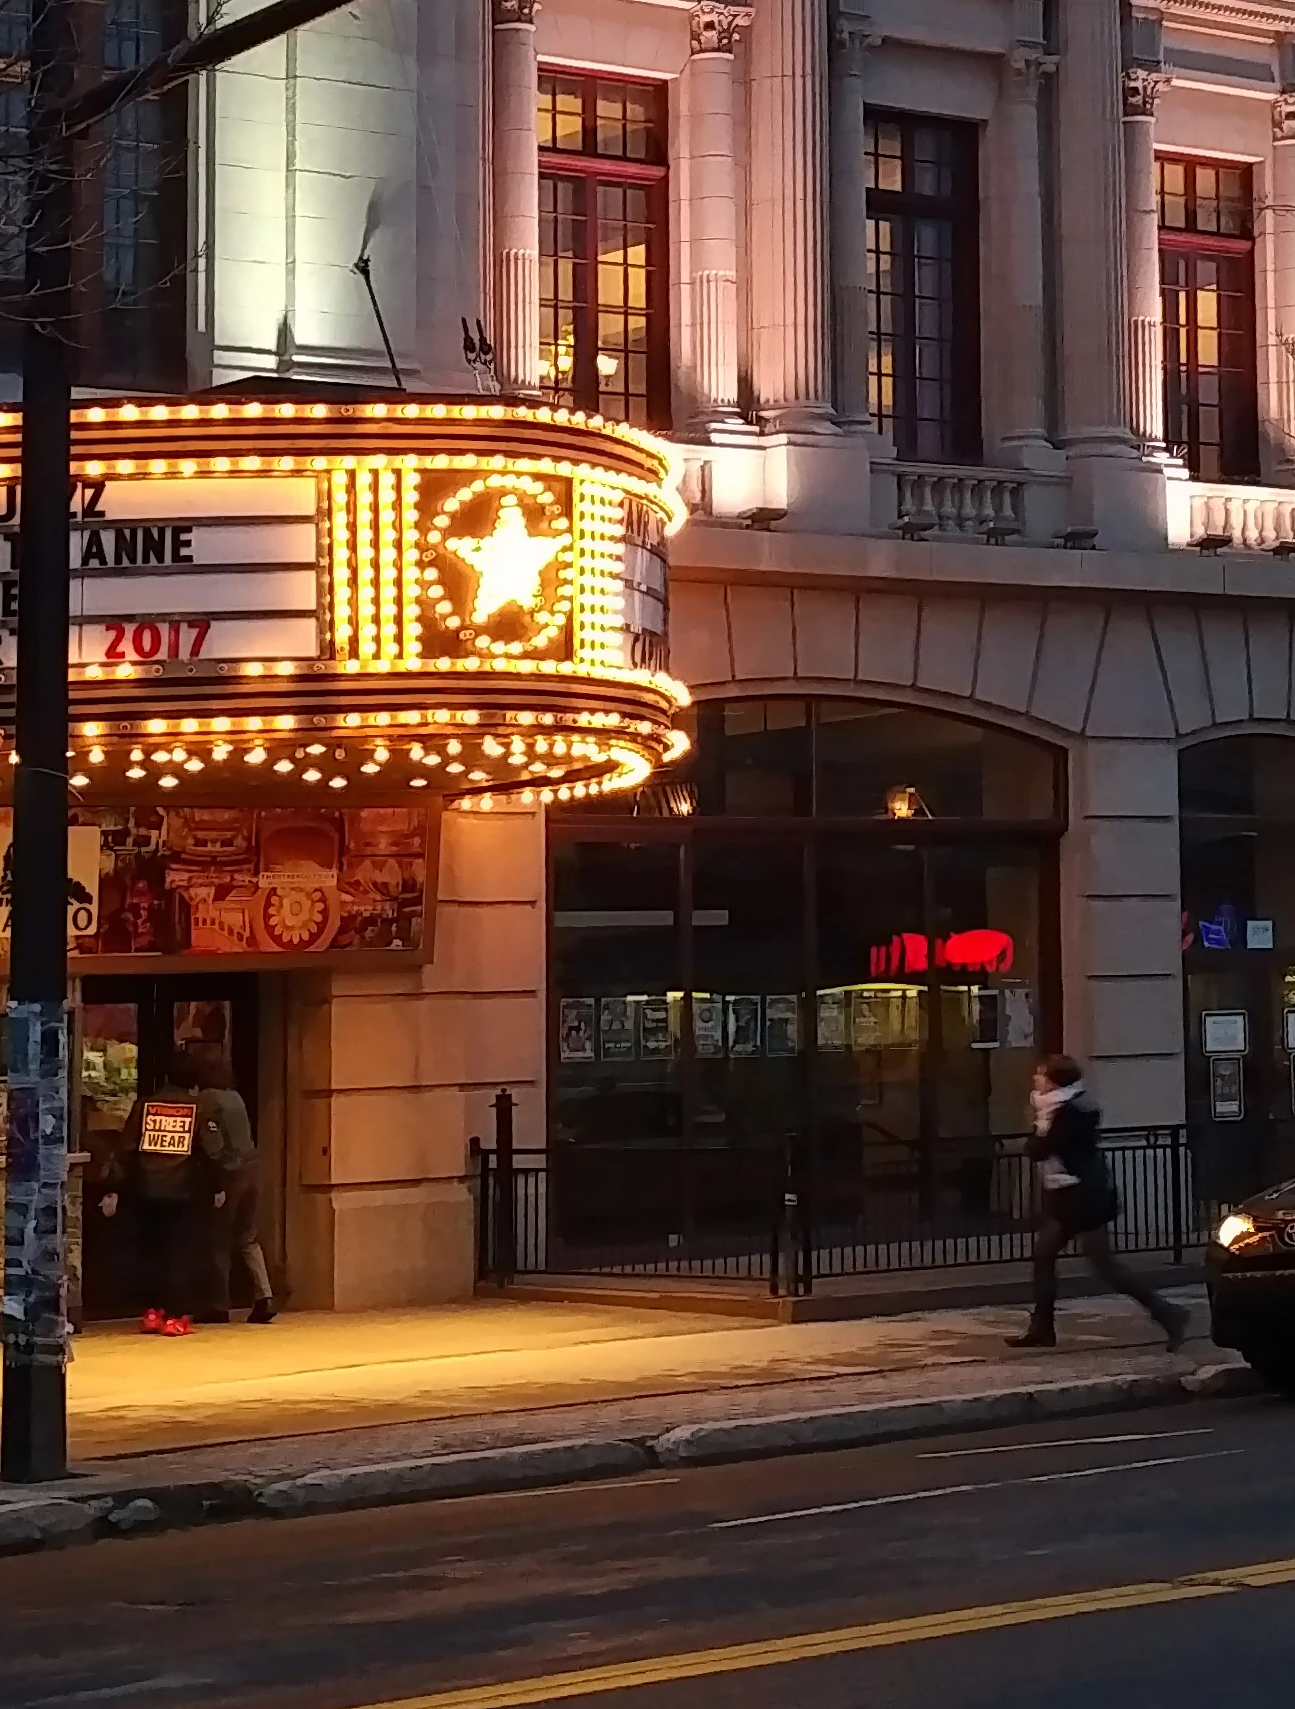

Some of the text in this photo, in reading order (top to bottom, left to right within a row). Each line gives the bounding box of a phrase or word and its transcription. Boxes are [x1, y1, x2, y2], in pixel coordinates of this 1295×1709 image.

[81, 525, 194, 567] ANNE
[105, 619, 211, 659] 2017
[145, 1115, 192, 1132] STREET
[147, 1133, 187, 1149] WEAR
